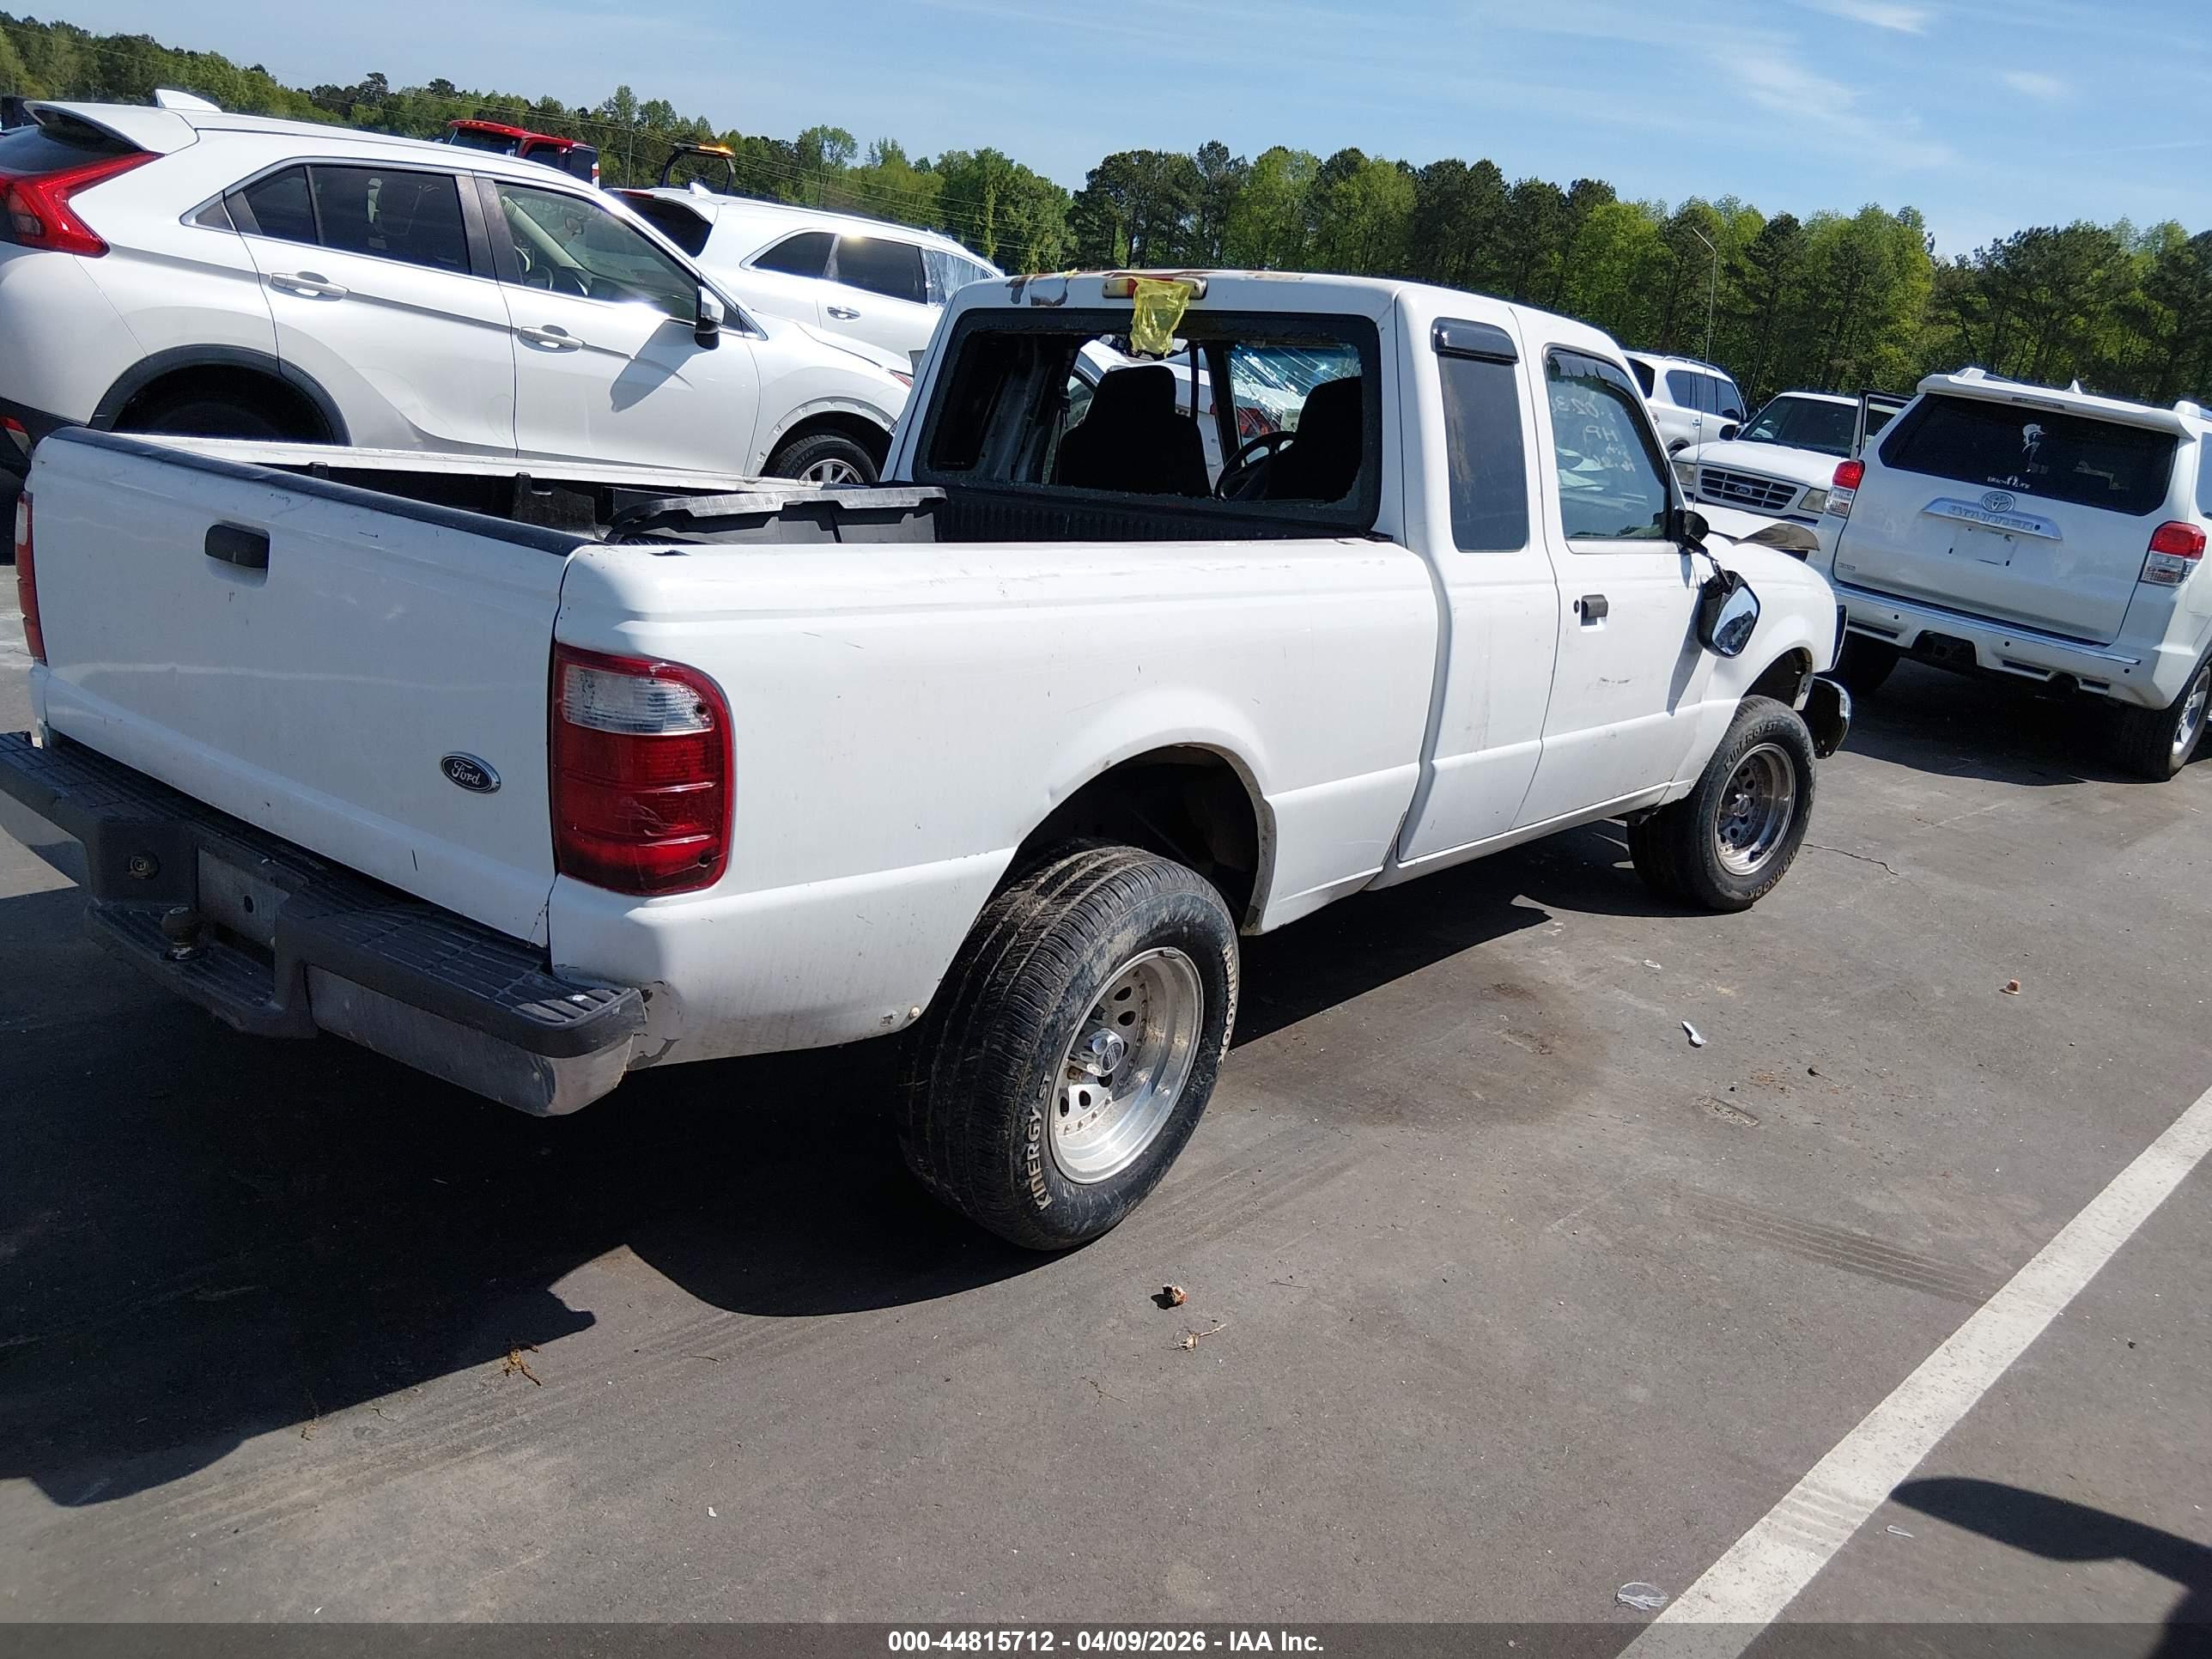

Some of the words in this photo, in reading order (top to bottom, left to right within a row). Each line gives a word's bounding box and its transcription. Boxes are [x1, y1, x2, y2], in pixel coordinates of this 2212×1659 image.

[451, 760, 482, 785] Ford
[1038, 1071, 1053, 1101] ST
[1026, 1105, 1054, 1212] KINERGY
